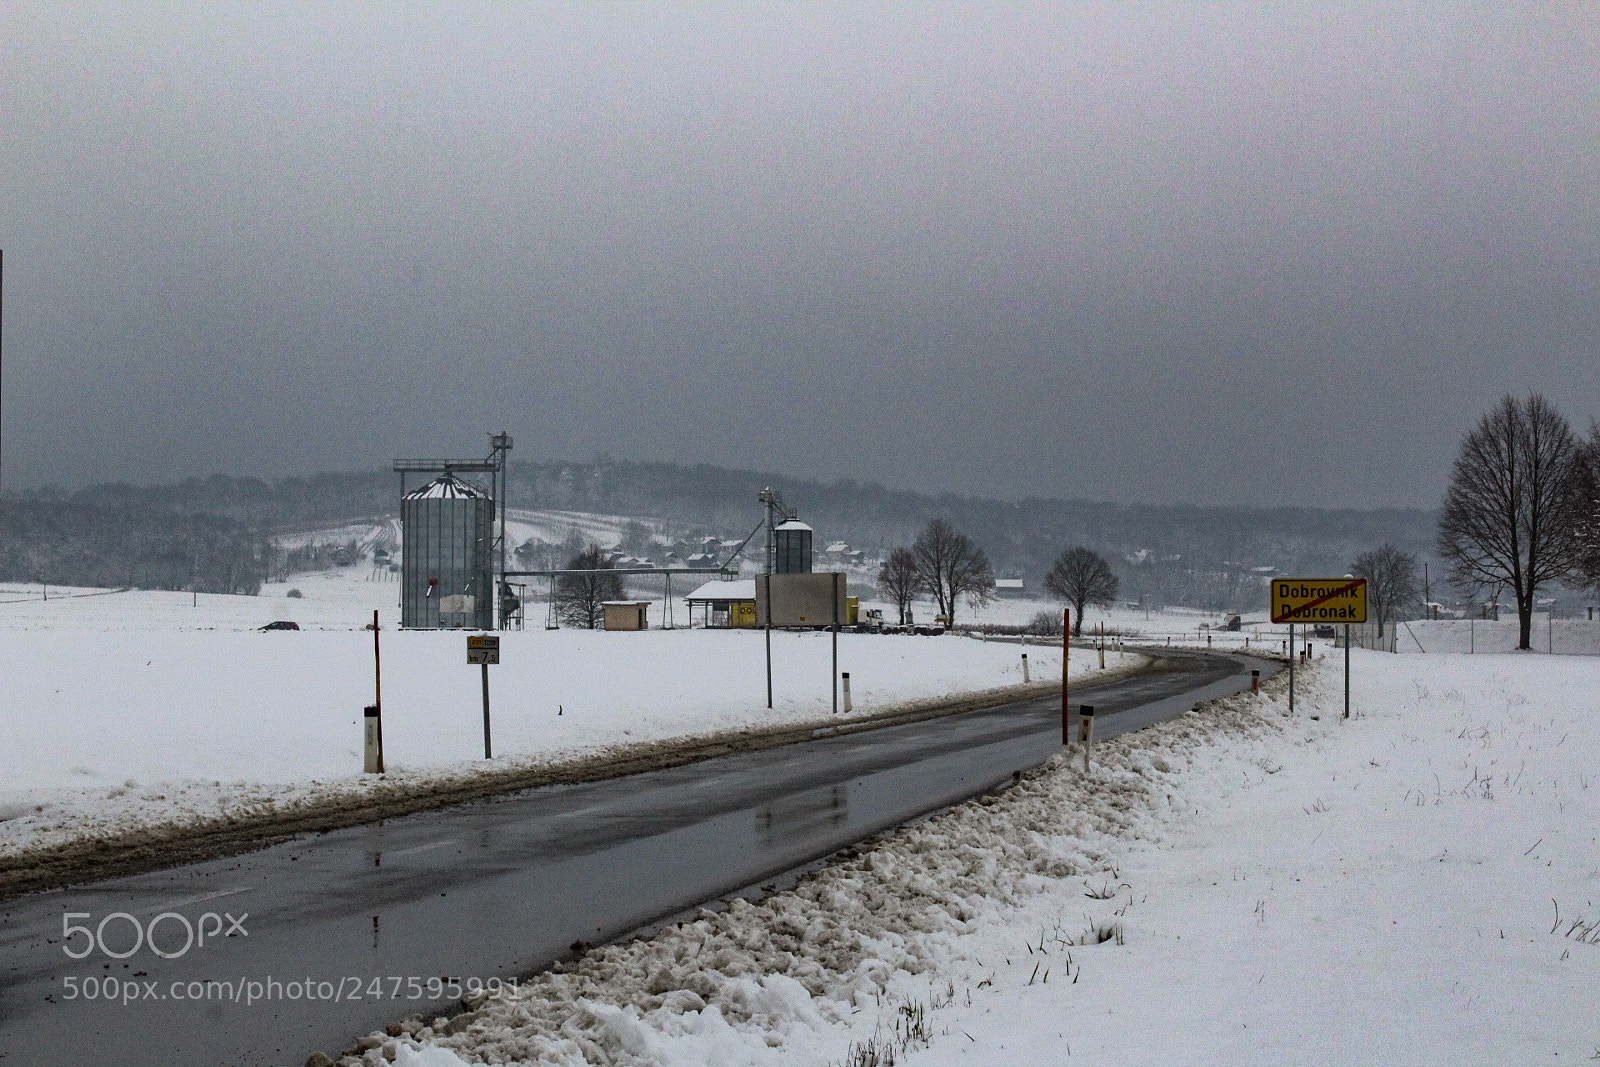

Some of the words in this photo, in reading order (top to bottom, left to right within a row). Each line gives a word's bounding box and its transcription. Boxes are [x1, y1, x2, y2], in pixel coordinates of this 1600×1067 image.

[1279, 584, 1359, 598] Dobrovnik
[1281, 604, 1357, 618] Dobronak
[482, 651, 496, 663] 7,5
